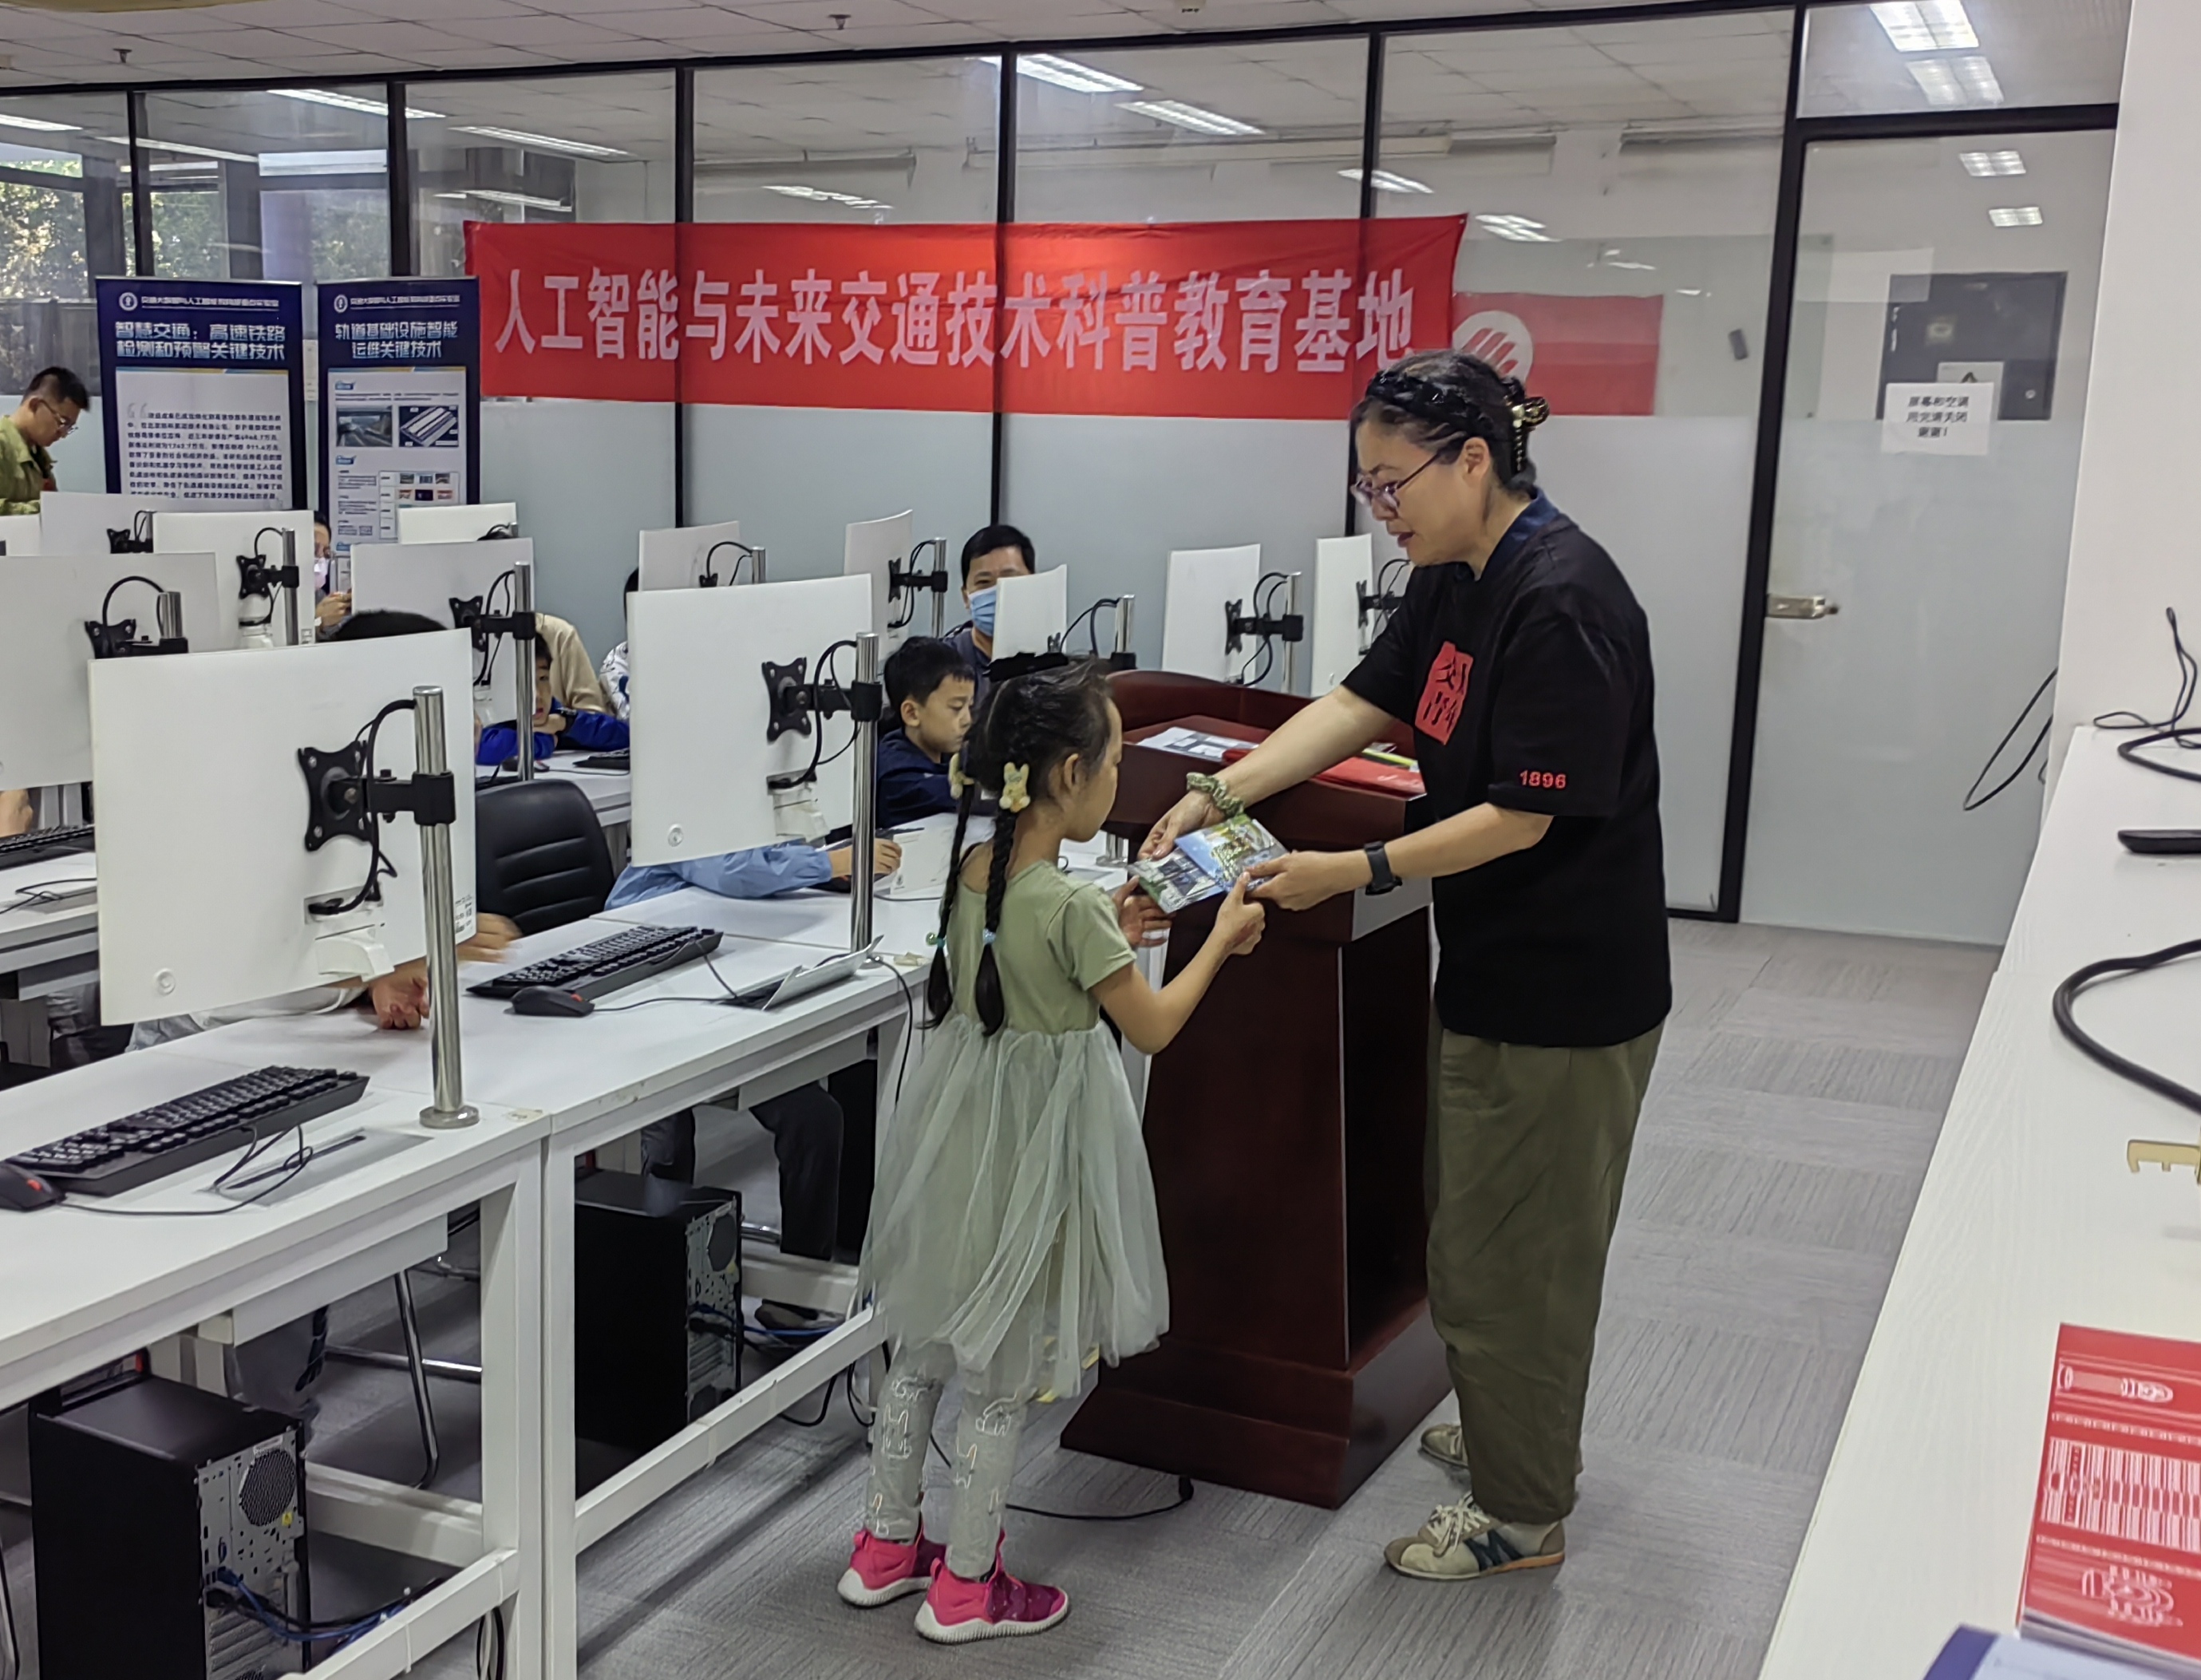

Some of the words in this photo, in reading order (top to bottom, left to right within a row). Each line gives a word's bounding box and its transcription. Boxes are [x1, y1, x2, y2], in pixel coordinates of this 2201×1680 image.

[495, 266, 1414, 374] 人工智能与未来交通技术科普教育基地
[334, 321, 459, 340] 轨道基础设施智能
[116, 340, 286, 361] 检测和预警关键技术
[352, 341, 442, 359] 运维关键技术
[1519, 769, 1567, 789] 1896
